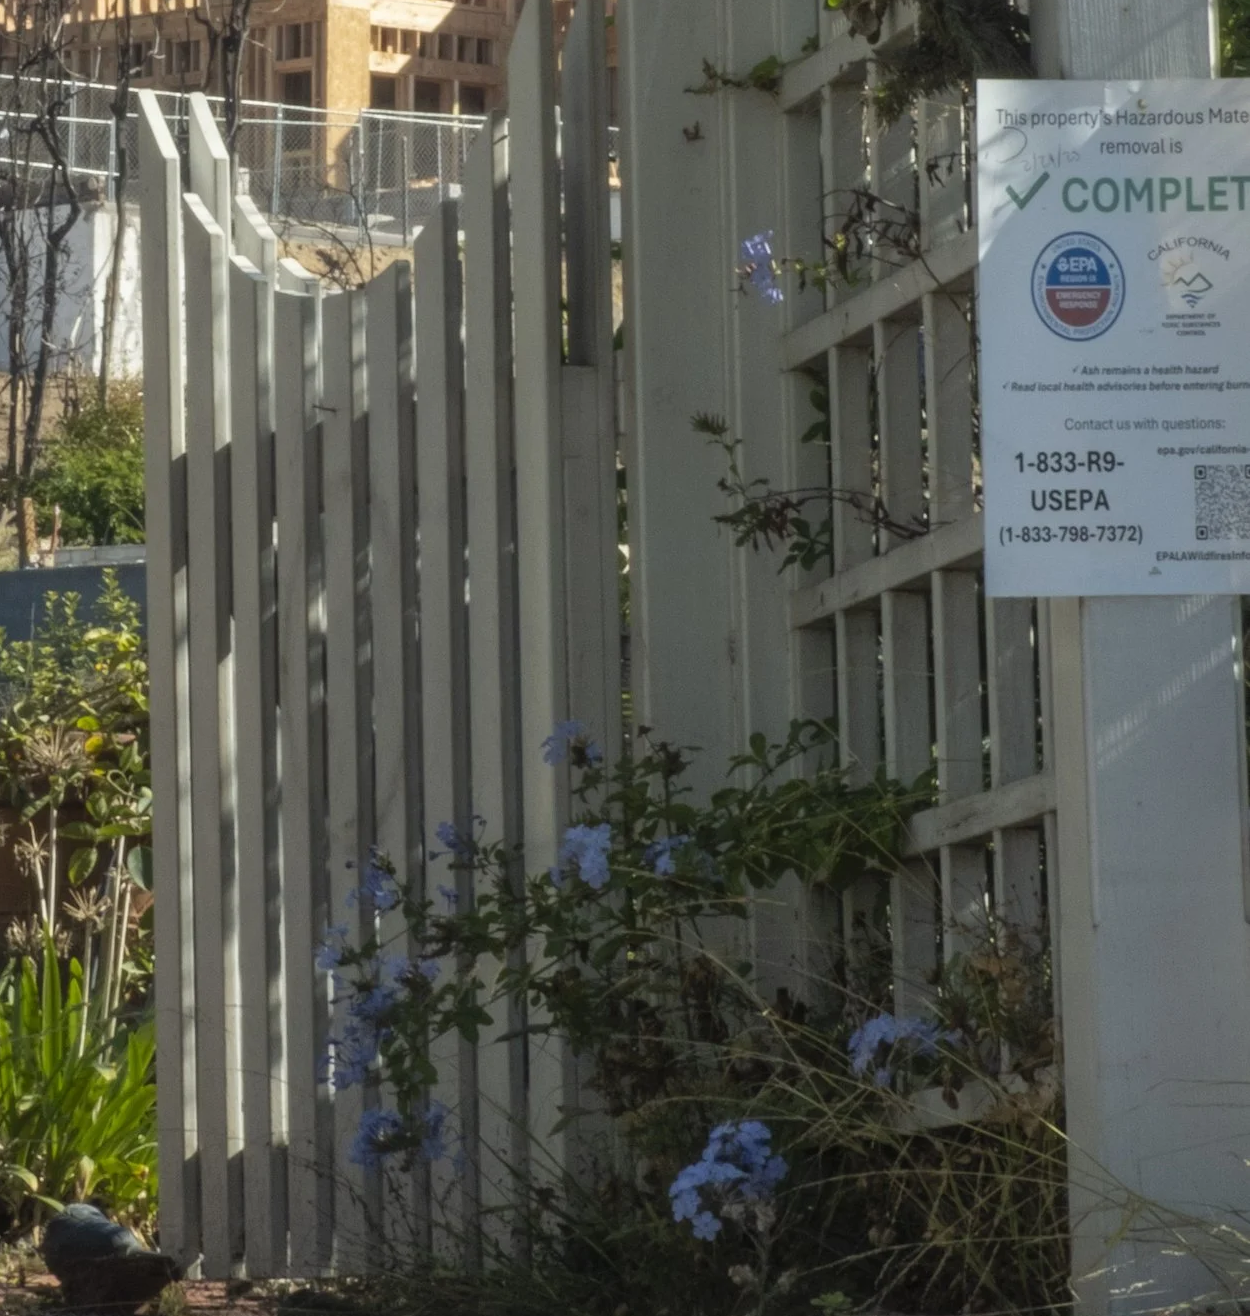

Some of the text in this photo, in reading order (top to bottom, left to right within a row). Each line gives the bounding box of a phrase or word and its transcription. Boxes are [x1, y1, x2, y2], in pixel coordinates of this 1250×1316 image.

[996, 108, 1027, 125] This
[1031, 109, 1112, 128] property's
[1116, 108, 1204, 126] Hazardous
[1100, 138, 1183, 155] removal is
[1061, 175, 1250, 213] COMPLET
[1147, 236, 1230, 261] CALIFORNIA
[1069, 256, 1098, 273] EPA
[1081, 364, 1219, 375] Ash remains a health hazard
[1011, 381, 1036, 391] Read
[1038, 381, 1062, 391] local
[1063, 381, 1095, 391] health
[1097, 380, 1147, 391] advisories
[1149, 380, 1181, 391] before
[1183, 380, 1224, 392] entering
[1064, 417, 1226, 432] Contact us with questions:
[1014, 451, 1125, 473] 1-833-R9-
[1031, 489, 1110, 511] USEPA
[999, 525, 1143, 546] (1-833-798-7372)
